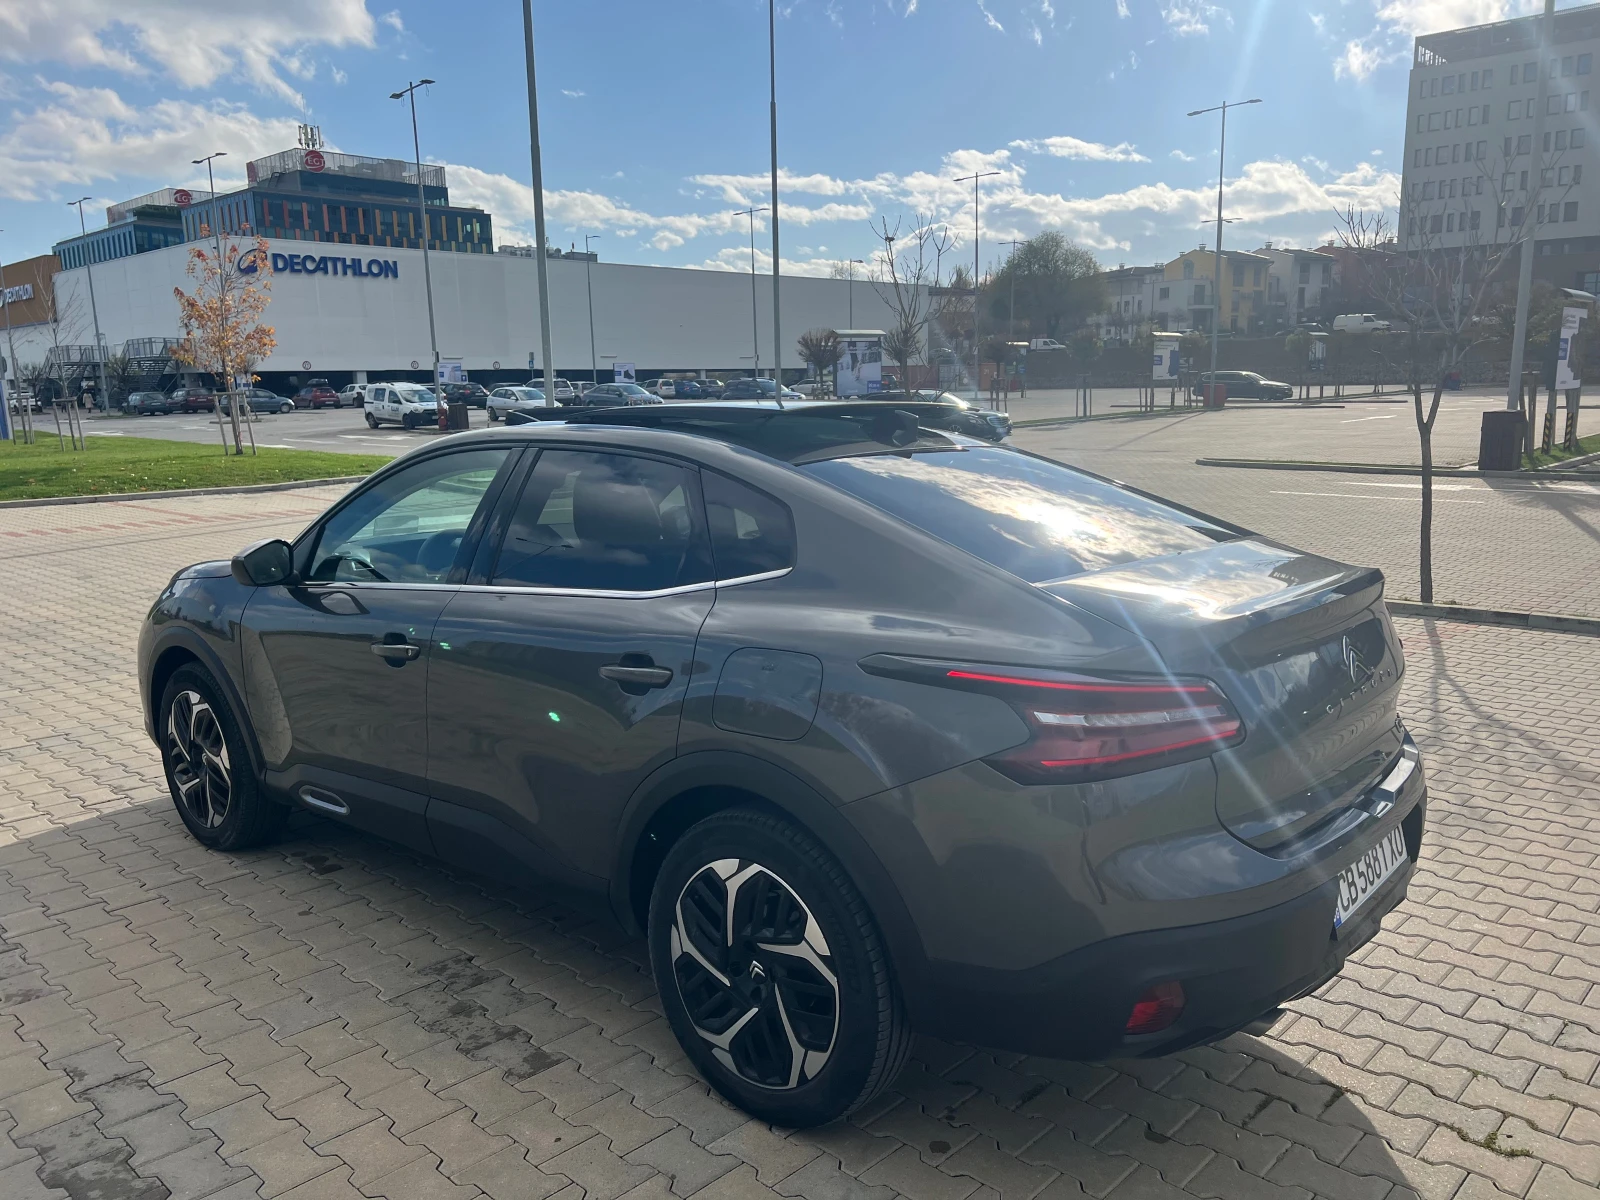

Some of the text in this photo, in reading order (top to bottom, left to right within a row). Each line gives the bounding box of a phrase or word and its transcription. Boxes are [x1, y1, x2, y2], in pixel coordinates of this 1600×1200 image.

[307, 156, 324, 167] EGT
[272, 253, 398, 278] DECATHLON
[1340, 867, 1358, 912] CB
